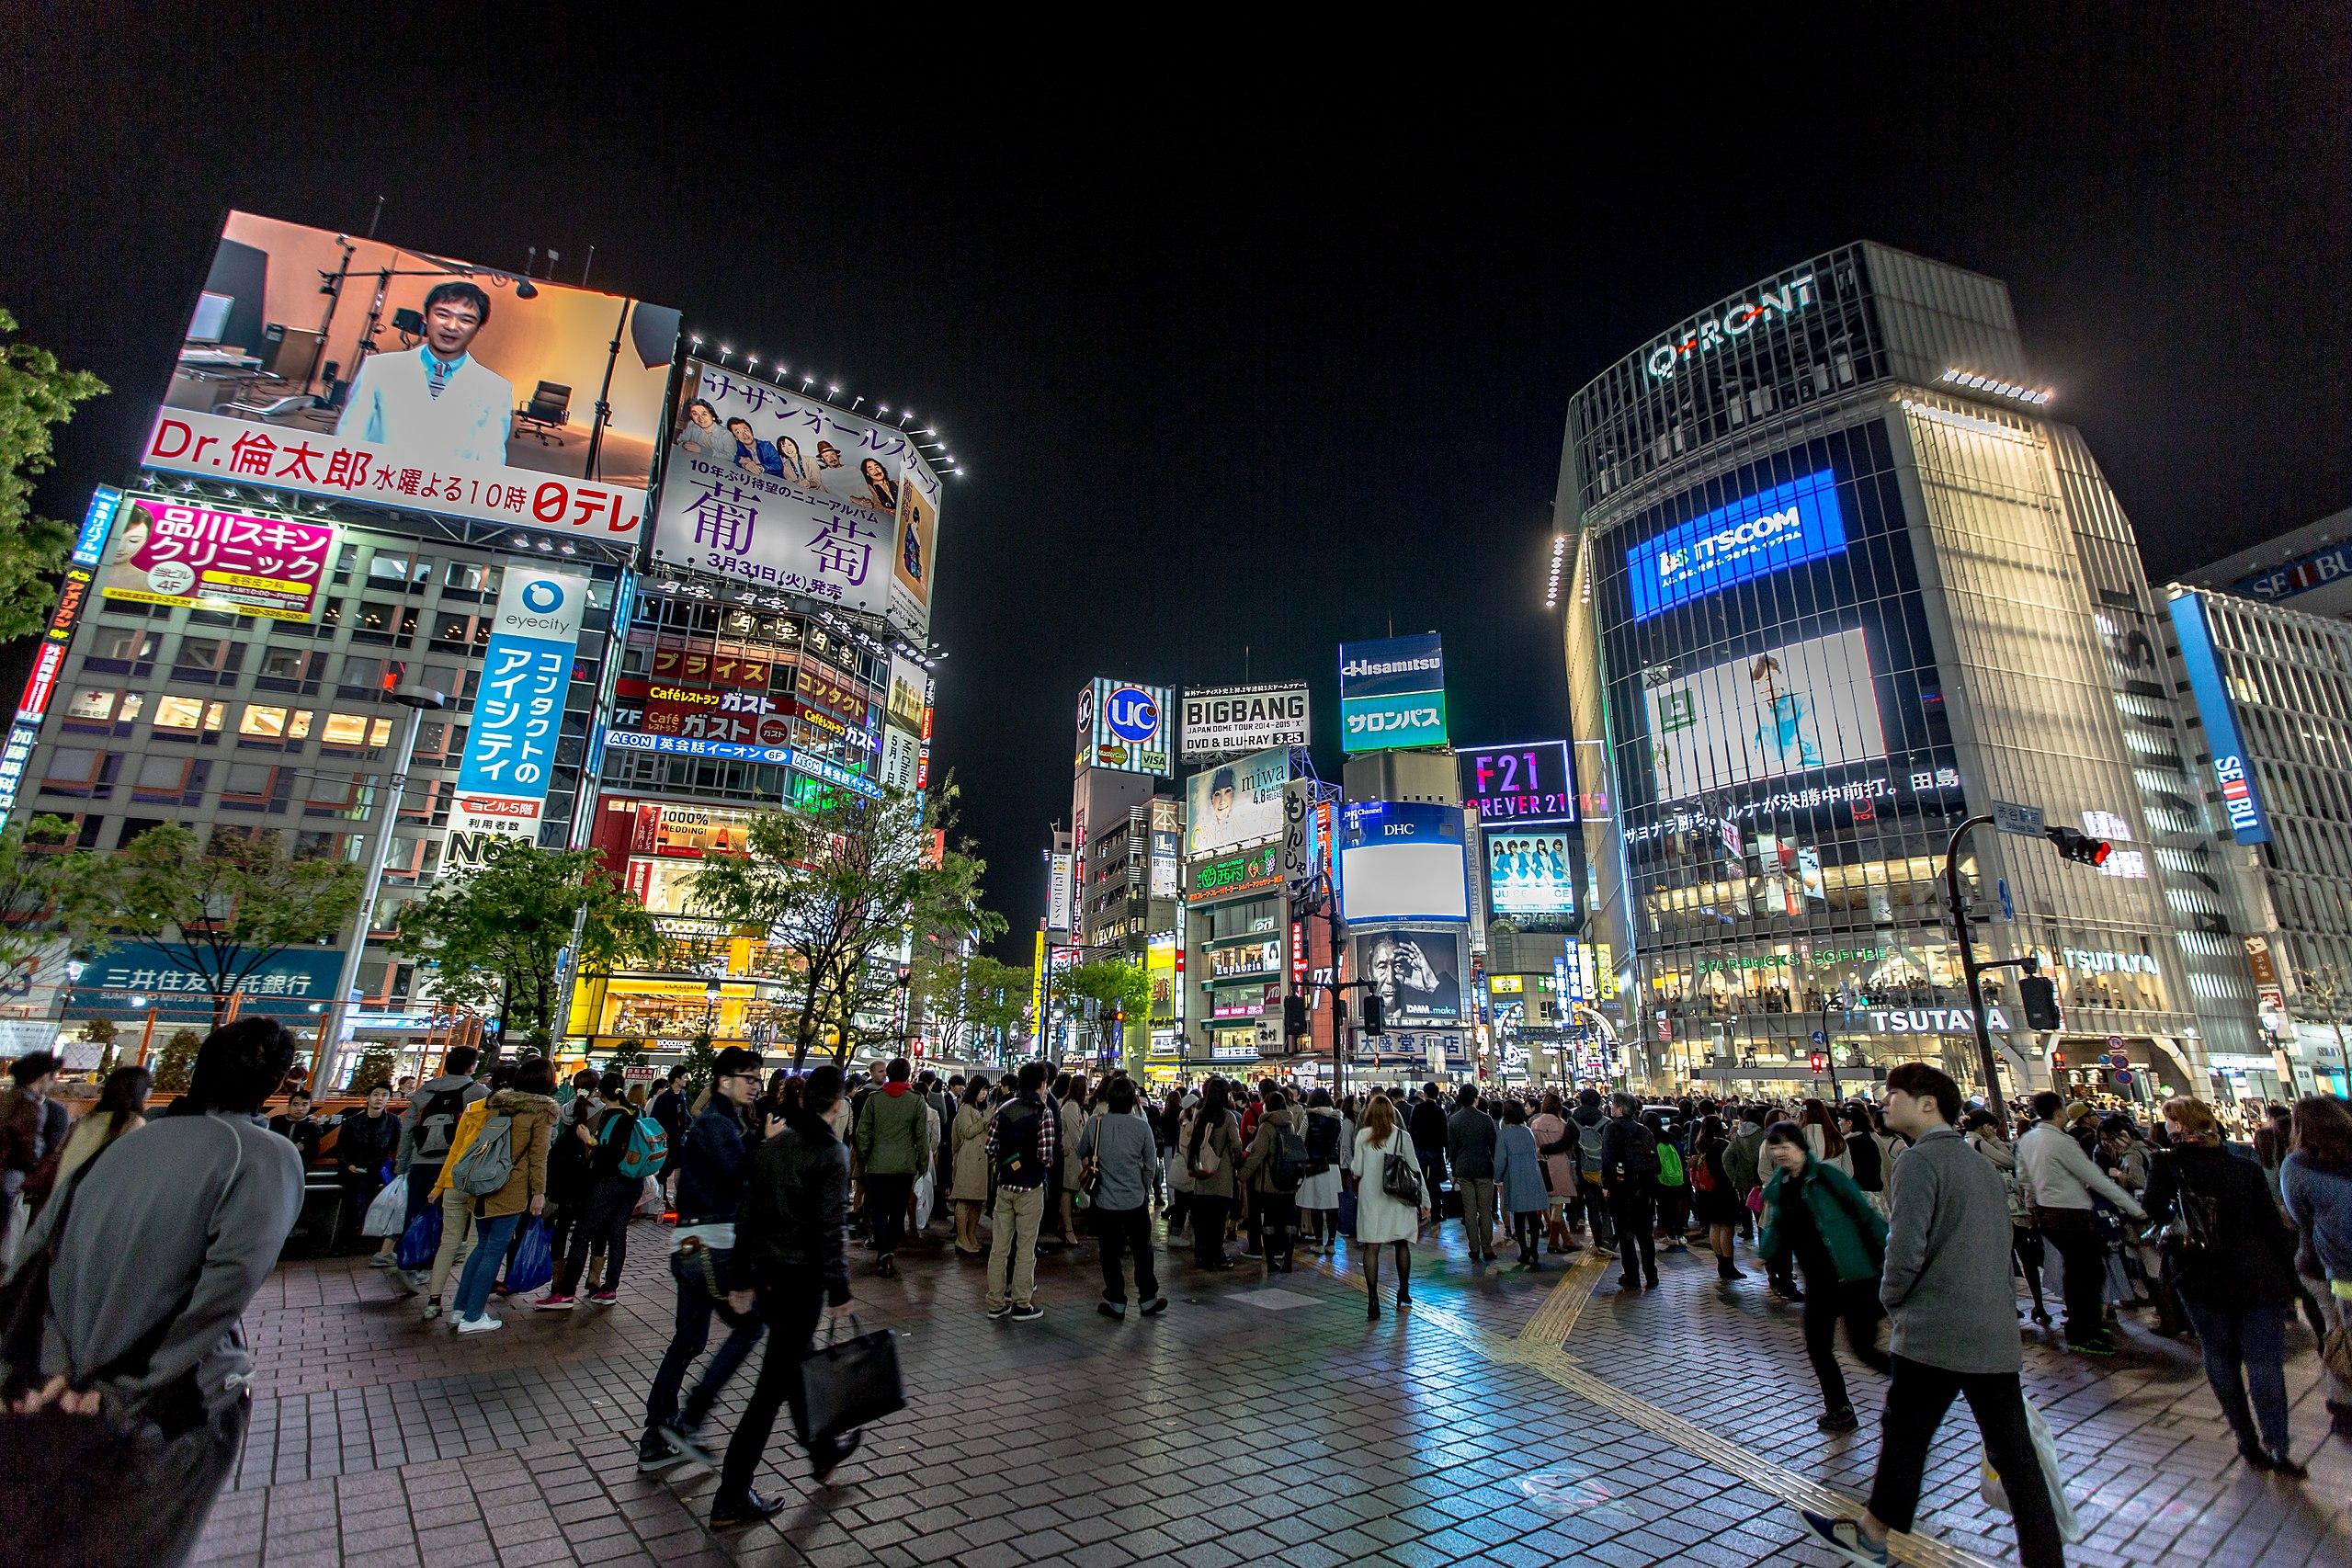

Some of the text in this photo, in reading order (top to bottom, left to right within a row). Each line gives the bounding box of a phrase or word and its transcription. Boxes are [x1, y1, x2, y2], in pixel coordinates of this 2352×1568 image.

[150, 418, 372, 492] Dr.倫太郎
[372, 466, 528, 514] 水曜よる10時
[689, 459, 880, 524] 10年ぶり待望のニューアルバム
[153, 507, 328, 551] 品川スキン
[1693, 506, 1800, 562] ITSCOM
[149, 536, 321, 579] クリニック
[157, 580, 180, 591] 4F
[229, 574, 286, 589] 美容皮フ科
[706, 551, 843, 599] 3月31日(火)発売
[2253, 550, 2352, 598] SEIBU
[505, 614, 570, 635] eyecity
[655, 653, 767, 683] プライス
[1341, 656, 1441, 677] Hisamitsu
[650, 686, 777, 715] Caféレストラン ガスト
[798, 672, 866, 718] コンタクト
[475, 647, 532, 781] アイシティ
[514, 652, 562, 784] コンタクトの
[615, 708, 643, 724] 7F
[648, 711, 680, 726] Café
[1079, 698, 1091, 727] UC
[1112, 699, 1155, 730] UC
[1187, 696, 1304, 726] BIGBANG
[1347, 708, 1440, 733] サロンパス
[610, 733, 652, 747] AEON
[647, 723, 678, 733] レストラン
[681, 713, 753, 743] ガスト
[763, 729, 786, 739] ガスト
[804, 710, 877, 751] Caféレストラン ガスト
[1187, 725, 1211, 734] JAPAN
[1213, 724, 1233, 733] DOME
[1234, 723, 1253, 732] TOUR
[658, 738, 782, 761] 英会話イーオン 6F
[1187, 733, 1301, 749] DVD & BLU-RAY 3.25
[794, 754, 821, 773] AEON
[1098, 749, 1128, 760] MasterCard
[1143, 755, 1165, 767] VISA
[900, 738, 913, 798] Mr.Childre
[1241, 765, 1286, 793] miwa
[1475, 751, 1540, 793] F21
[823, 766, 883, 800] 英会話イーオン
[1267, 790, 1284, 800] RELEAS
[1725, 767, 1960, 820] ルナが決勝中前打。 田島
[2212, 754, 2259, 831] SEIBU
[470, 800, 535, 816] 当ビル5階
[1253, 789, 1266, 805] 4.8
[1545, 793, 1566, 814] 21
[661, 810, 709, 825] 1000%
[1153, 802, 1177, 832] 本
[1358, 806, 1382, 816] Channel
[1997, 805, 2040, 826] 渋谷駅前
[468, 818, 519, 832] 利用者数
[660, 824, 707, 835] WEDDING!
[1285, 790, 1306, 876] もんじゃ
[1383, 823, 1415, 835] DHC
[1216, 960, 1262, 975] Euphoria
[1698, 946, 1889, 974] STARBUCKS COFFEE
[2062, 947, 2160, 975] TSUTAYA
[103, 968, 312, 995] 三井住友信託銀行
[1266, 985, 1280, 1001] JTB
[1406, 1004, 1457, 1015] DMM.make
[1361, 1035, 1460, 1053] 大盛堂店
